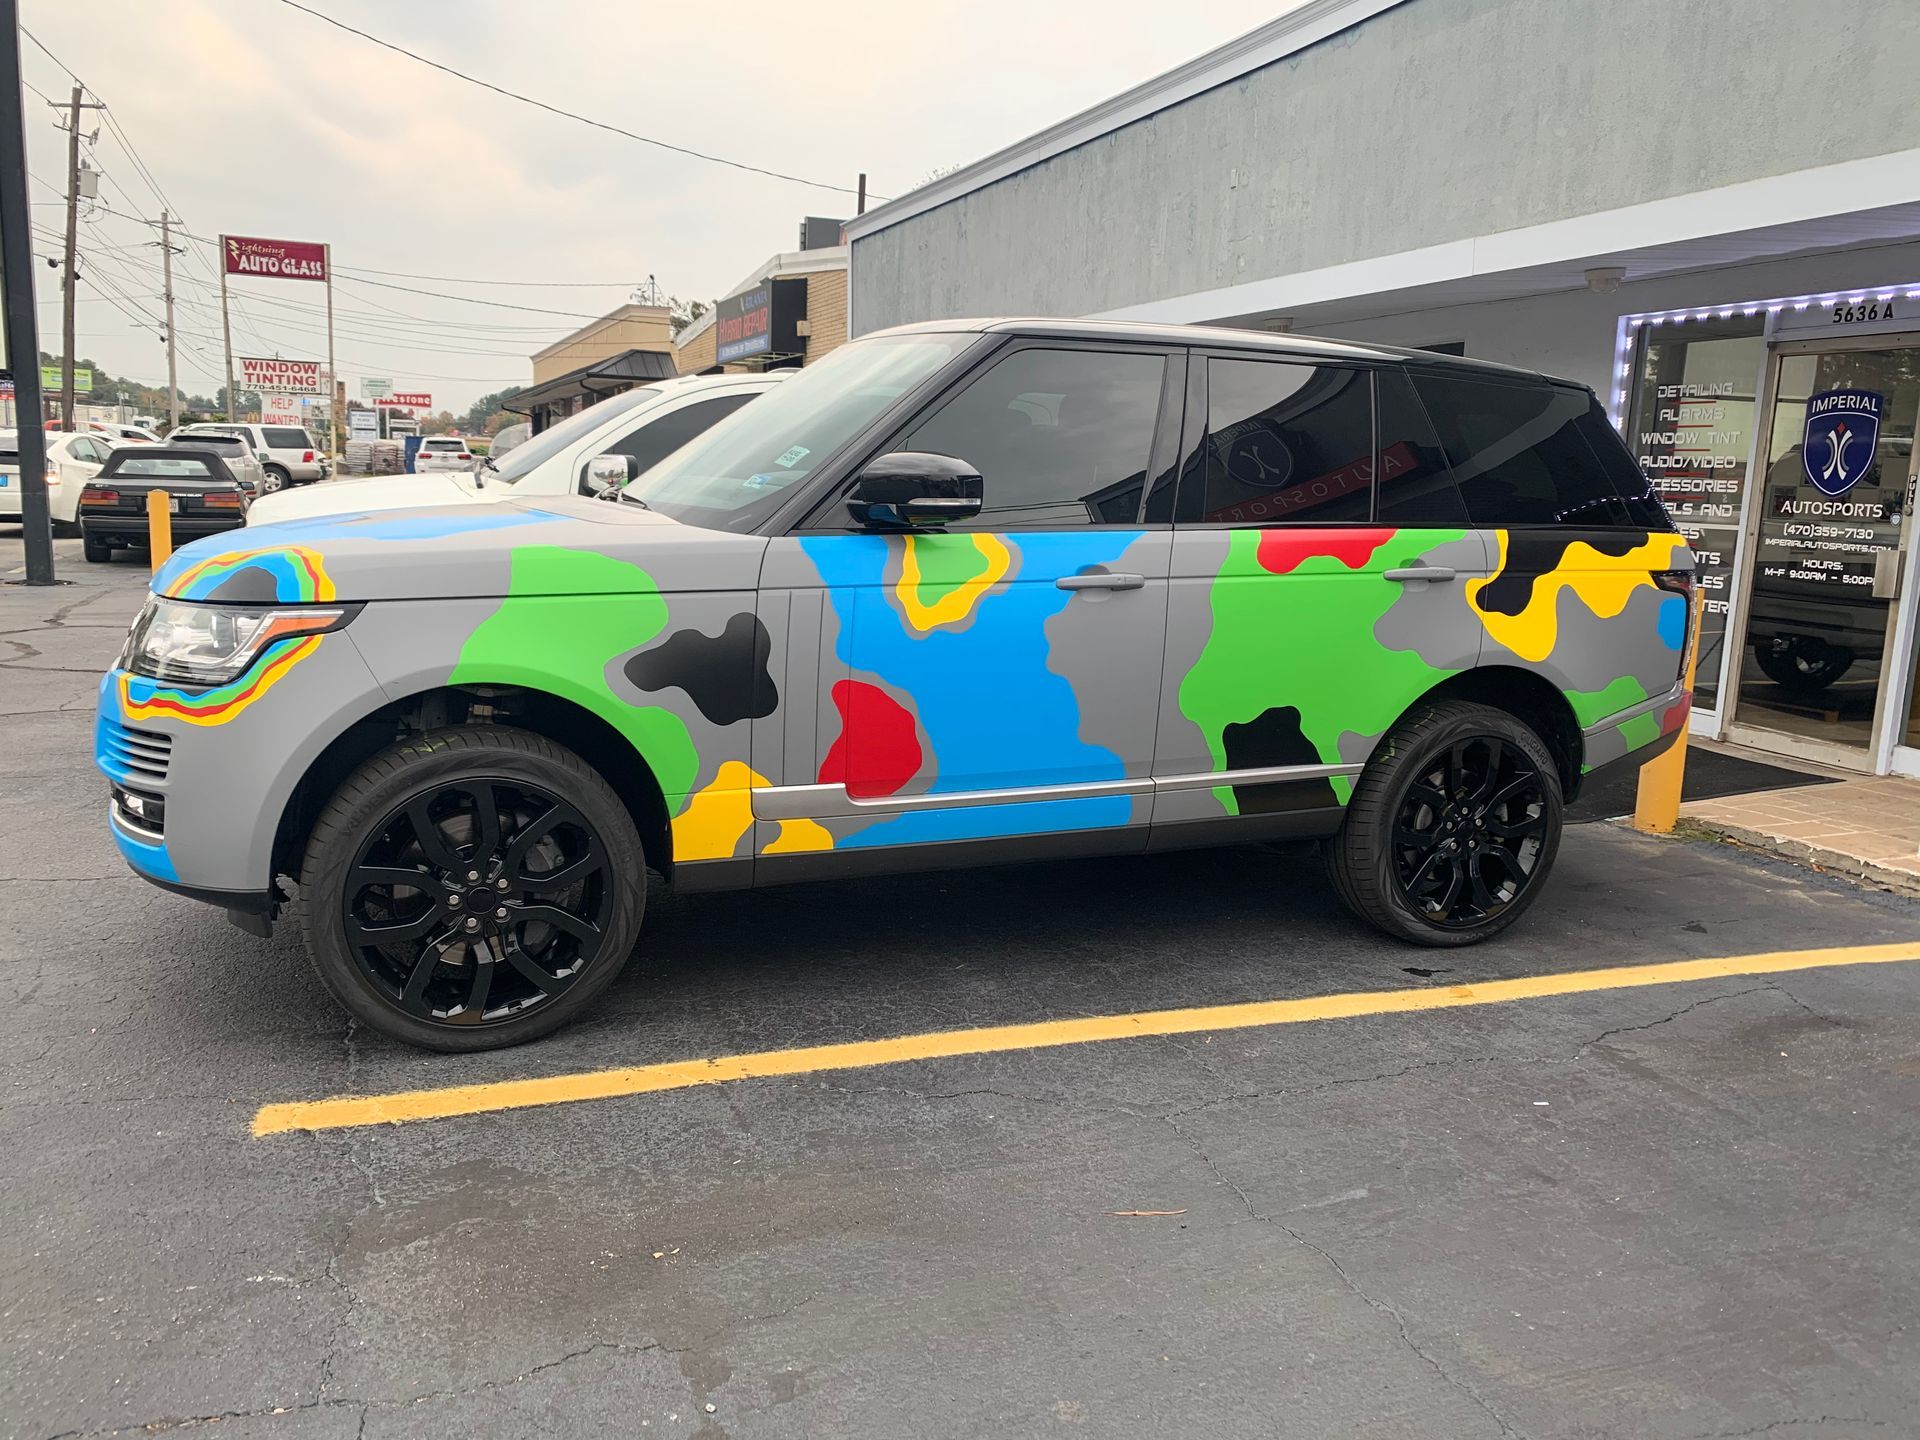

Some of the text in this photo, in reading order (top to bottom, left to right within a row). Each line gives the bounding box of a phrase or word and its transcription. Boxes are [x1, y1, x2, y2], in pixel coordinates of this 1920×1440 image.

[239, 255, 322, 276] AUTO GLASS
[1832, 303, 1894, 323] 5636 A
[242, 360, 317, 375] WINDOW
[244, 373, 317, 387] TINTING
[245, 383, 317, 393] 770-451-6468
[1657, 382, 1734, 398] DETAILING
[271, 397, 293, 410] HELP
[1811, 395, 1878, 414] IMPERIAL
[263, 413, 300, 425] WANTED
[1659, 408, 1725, 421] ALARMS
[1641, 431, 1741, 445] WINDOW TINT
[1639, 455, 1737, 469] AUDIO/VIDEO
[1650, 478, 1739, 493] CESSORIES
[1907, 475, 1917, 505] PULL
[1700, 503, 1733, 517] AND
[1780, 500, 1883, 518] AUTOSPORTS
[1783, 522, 1874, 540] (470)359-7130
[1802, 559, 1844, 571] HOURS:
[1764, 567, 1785, 577] M-F
[1789, 570, 1827, 582] 9:00AM
[1842, 574, 1875, 586] 5:00P
